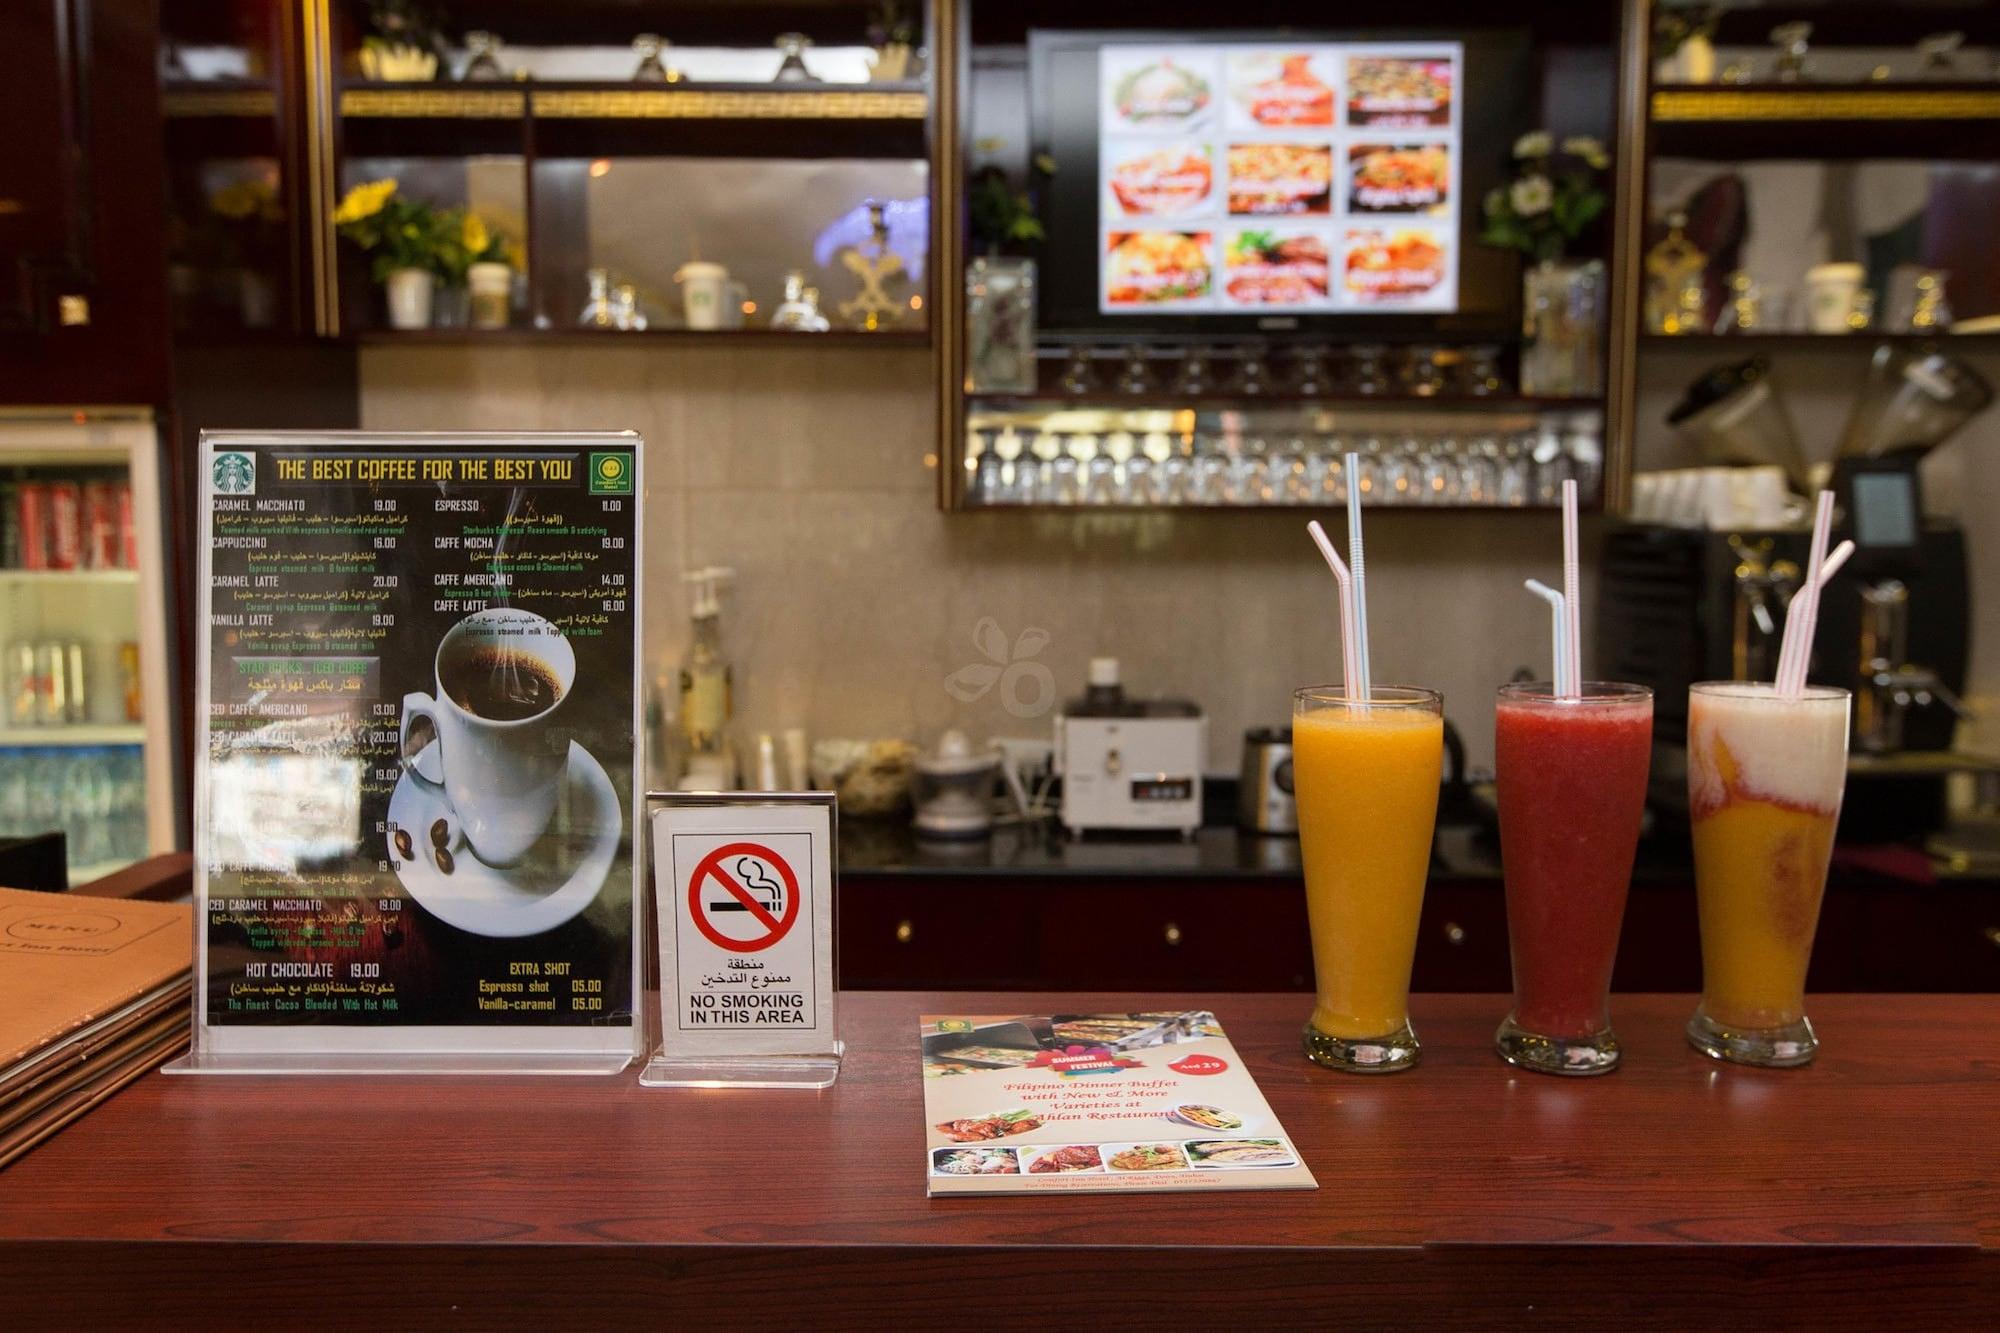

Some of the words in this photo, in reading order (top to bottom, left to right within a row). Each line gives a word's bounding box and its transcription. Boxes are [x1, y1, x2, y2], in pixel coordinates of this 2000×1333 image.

[278, 460, 305, 480] THE
[313, 460, 352, 480] BEST
[358, 460, 416, 480] COFFEE
[423, 460, 452, 480] FOR
[459, 460, 487, 480] THE
[495, 460, 535, 480] BEST
[540, 460, 571, 480] YOU
[213, 500, 249, 511] CARAMEL
[257, 500, 304, 511] MACCHIATO
[374, 500, 396, 511] 19.00
[435, 501, 479, 511] ESPRESSO
[603, 501, 621, 511] 11.00
[213, 538, 266, 549] CAPPUCCINO
[374, 538, 396, 549] 16.00
[435, 537, 459, 548] CAFFE
[464, 537, 493, 548] MOCHA
[602, 537, 624, 548] 19.00
[212, 576, 249, 587] CARAMEL
[255, 576, 279, 587] LATTE
[373, 576, 397, 587] 20.00
[435, 574, 459, 585] CAFFE
[463, 574, 512, 585] AMERICANO
[602, 574, 624, 585] 14.00
[434, 600, 459, 611] CAFFE
[463, 600, 487, 611] LATTE
[603, 600, 624, 611] 16.00
[211, 615, 244, 626] VANILLA
[250, 615, 273, 626] LATTE
[373, 615, 394, 626] 19.00
[210, 704, 224, 715] CED
[230, 704, 253, 715] CAFFE
[259, 704, 307, 715] AMERICANO
[373, 704, 395, 715] 13.00
[210, 732, 224, 743] CED
[373, 732, 398, 743] 20.00
[376, 769, 397, 781] 19.00
[378, 861, 400, 872] 190
[208, 900, 224, 911] CED
[229, 900, 267, 911] CARAMEL
[273, 900, 321, 911] MACCHIATO
[379, 900, 400, 911] 19.00
[510, 963, 539, 975] EXTRA
[545, 963, 571, 975] SHOT
[728, 959, 764, 969] منطقة
[247, 963, 267, 977] HOT
[271, 963, 333, 977] CHOCOLATE
[351, 963, 379, 977] 19.00
[701, 973, 747, 987] التدخين
[751, 974, 791, 988] ممنوع
[480, 980, 523, 994] Espresso
[529, 980, 549, 992] shot
[572, 980, 601, 992] 05.00
[228, 999, 241, 1010] The
[246, 999, 270, 1010] Finest
[305, 999, 337, 1010] Blended
[342, 999, 360, 1010] With
[364, 999, 378, 1010] Hot
[383, 999, 398, 1010] Milk
[478, 998, 555, 1010] Vanilla-caramel
[572, 998, 602, 1010] 05.00
[691, 995, 715, 1008] NO
[721, 995, 803, 1008] SMOKING
[691, 1011, 706, 1023] IN
[711, 1011, 750, 1023] THIS
[756, 1011, 804, 1023] AREA
[1052, 1055, 1096, 1064] SUMMER
[1071, 1061, 1115, 1070] FESTIVAL
[1003, 1082, 1065, 1092] Filipino
[1069, 1080, 1122, 1090] Dinner
[1127, 1079, 1180, 1089] Buffet
[1022, 1091, 1057, 1101] with
[1062, 1092, 1101, 1101] New
[1127, 1089, 1168, 1098] More
[1049, 1101, 1121, 1110] Varieties
[1125, 1100, 1142, 1108] at
[1087, 1109, 1176, 1121] Restaurant
